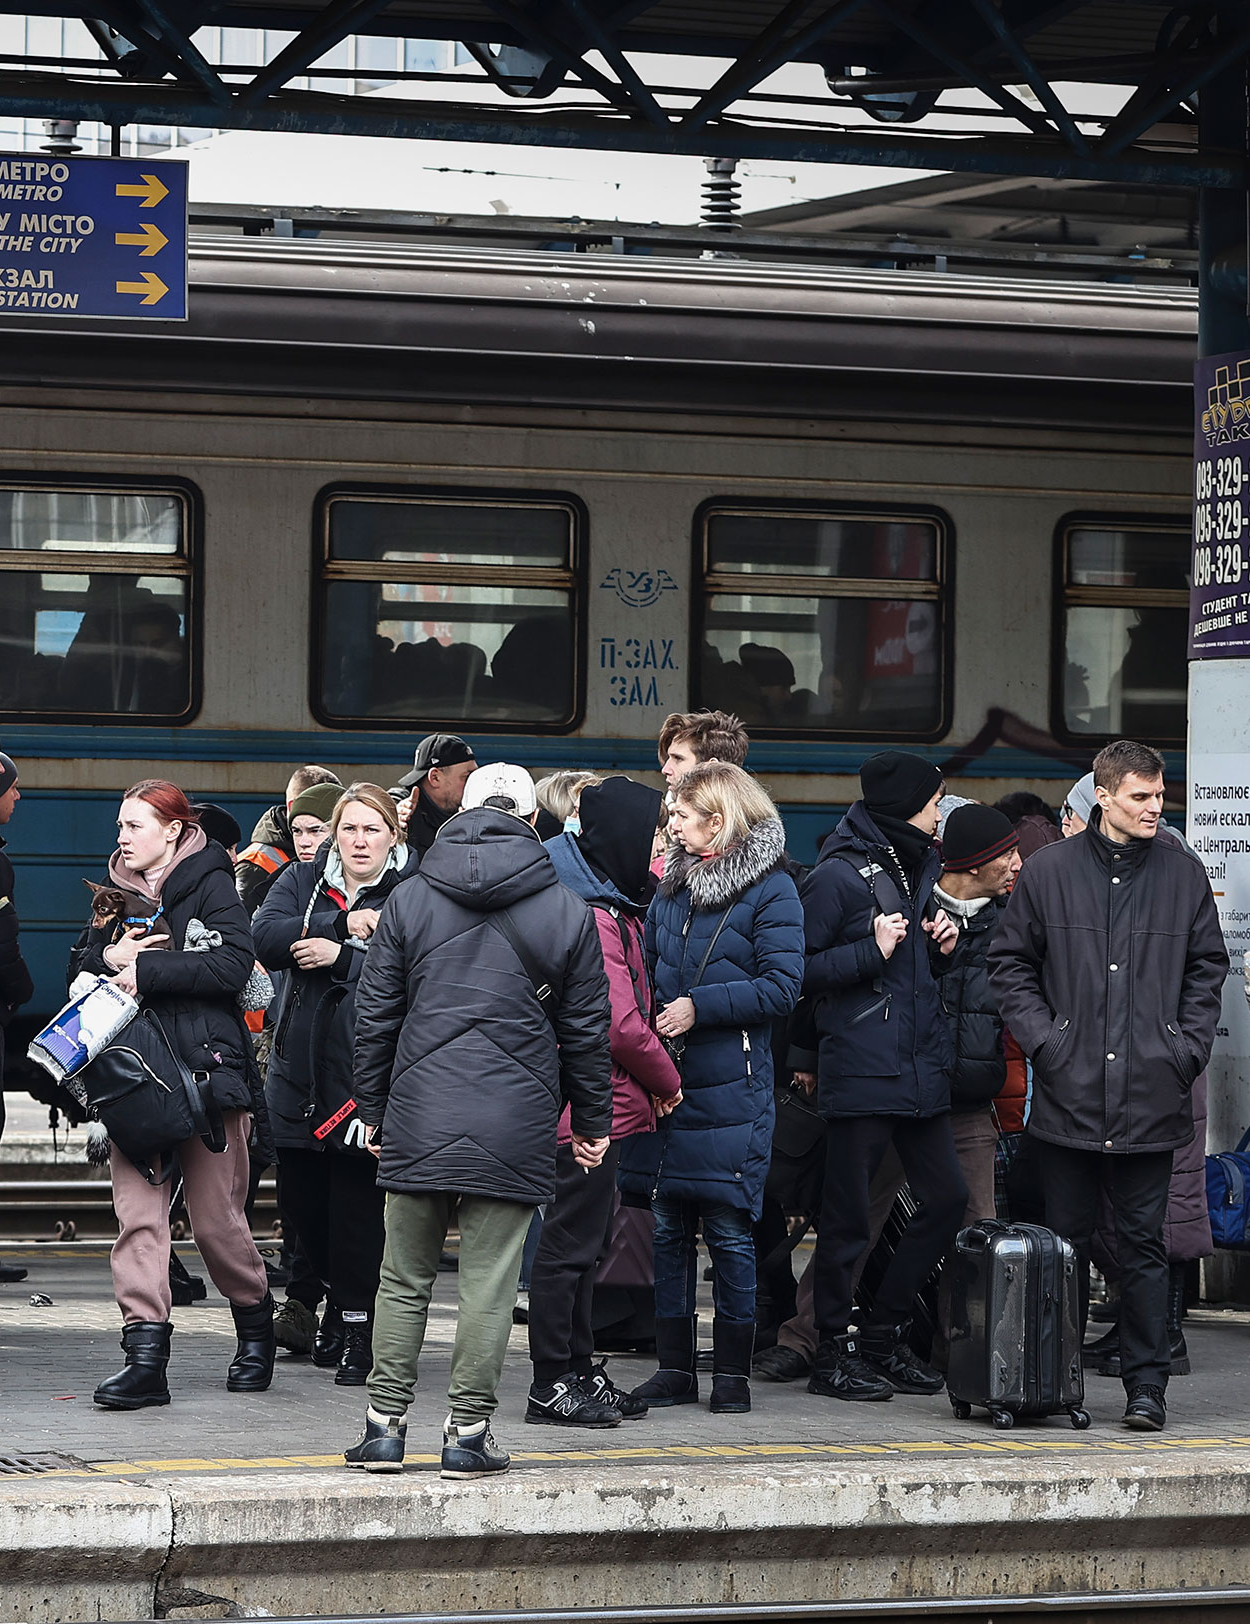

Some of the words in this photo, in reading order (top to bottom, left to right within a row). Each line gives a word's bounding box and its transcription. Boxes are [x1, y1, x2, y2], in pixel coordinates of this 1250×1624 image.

[19, 214, 95, 236] МІСТО
[39, 236, 84, 254] CITY
[1206, 423, 1250, 448] ТАК
[1196, 456, 1250, 500] 093-329-
[1195, 500, 1250, 544] 095-329-
[1194, 544, 1250, 587] 098-329-
[1202, 595, 1238, 615] СТУДЕНТ
[1193, 614, 1232, 638] ДЕШЕВШЕ
[1235, 610, 1249, 624] НЕ
[1194, 783, 1250, 800] Встановлює
[1194, 810, 1218, 826] новий
[1223, 927, 1250, 940] аломоб
